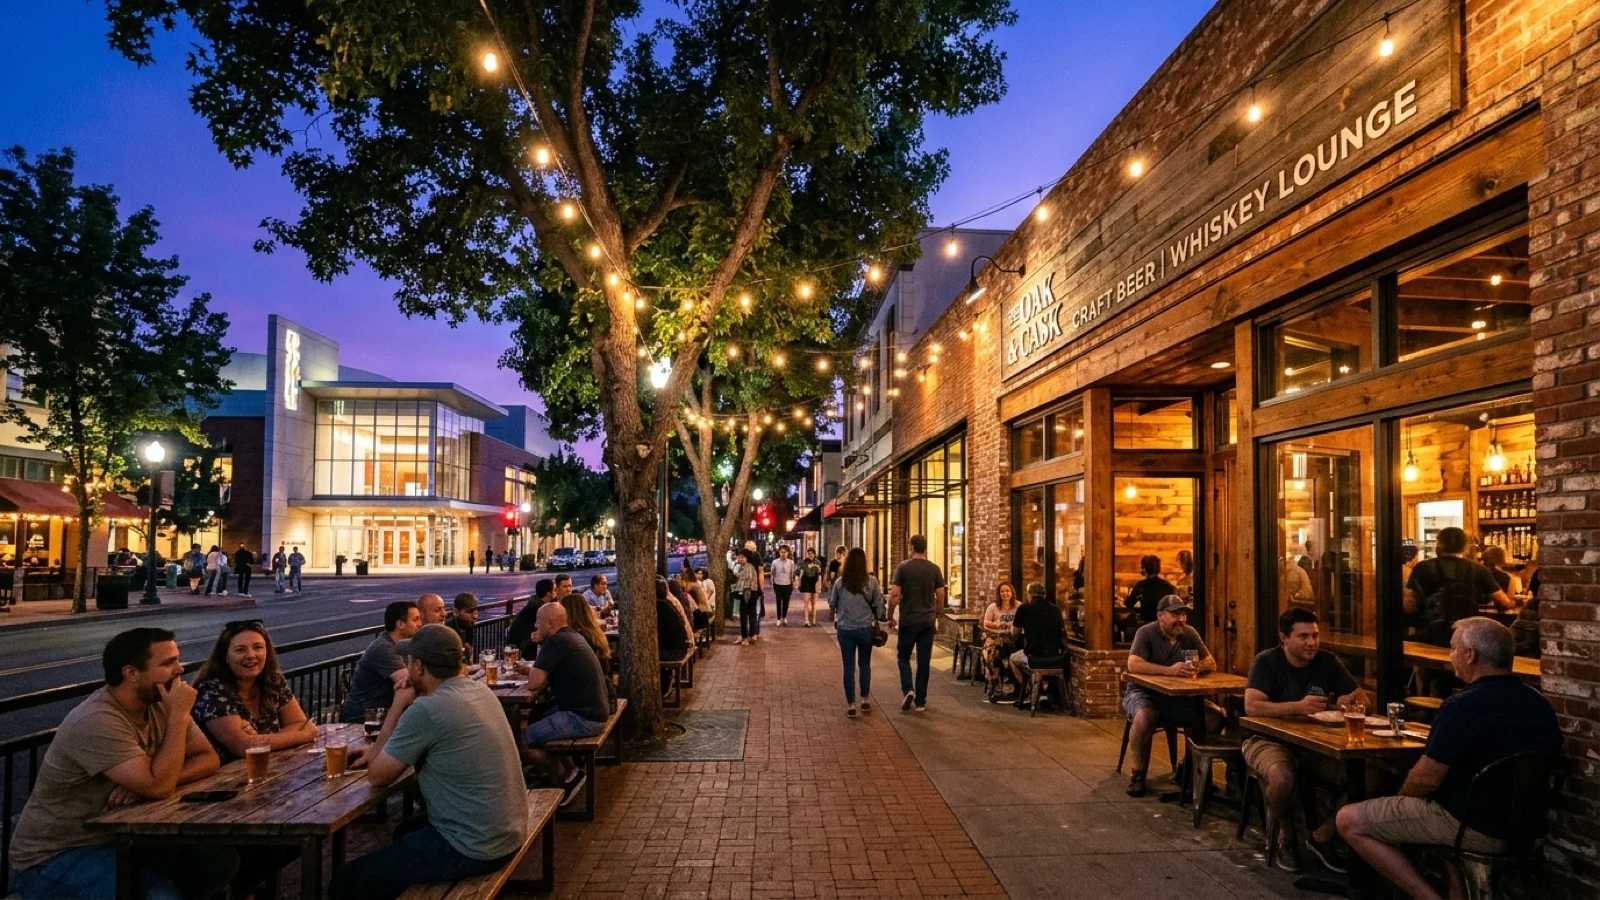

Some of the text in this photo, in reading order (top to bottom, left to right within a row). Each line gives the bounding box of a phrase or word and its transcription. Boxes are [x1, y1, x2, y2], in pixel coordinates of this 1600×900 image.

[1072, 288, 1113, 328] CRAFT
[1116, 261, 1156, 303] BEER
[1171, 180, 1271, 268] WHISKEY
[1278, 79, 1418, 200] LOUNGE
[1020, 272, 1056, 323] OAK
[1007, 302, 1064, 366] & CASK
